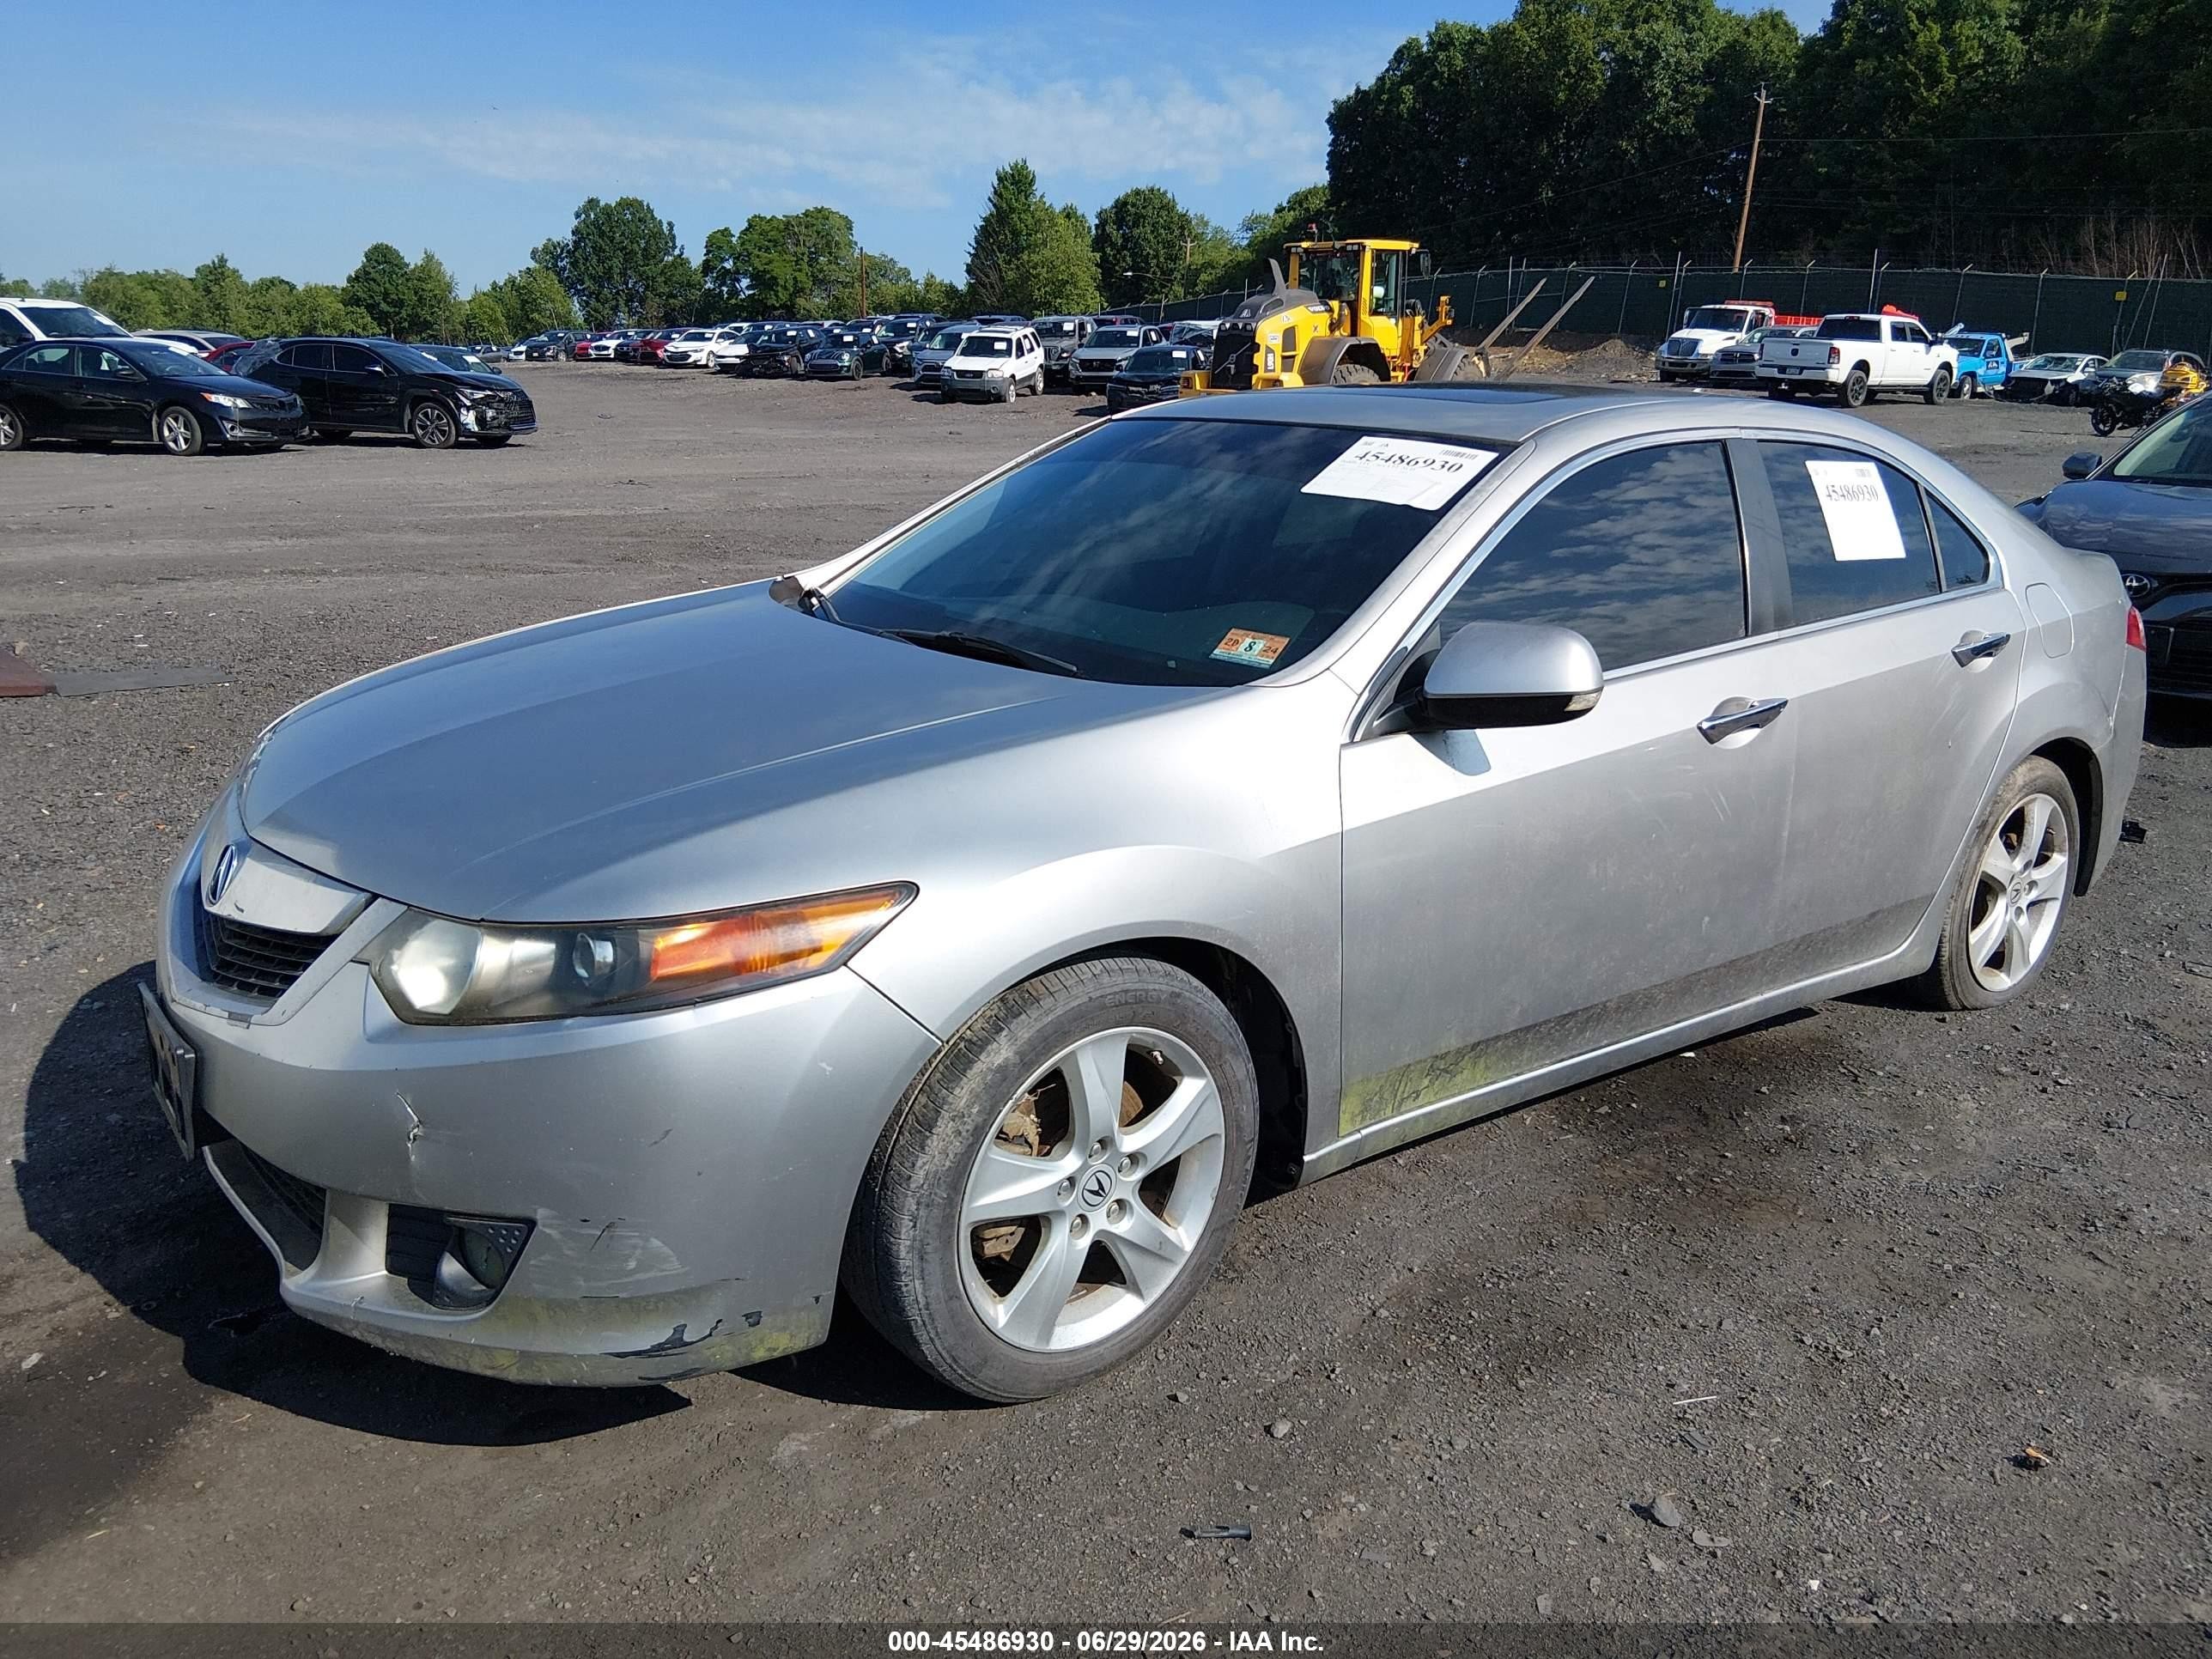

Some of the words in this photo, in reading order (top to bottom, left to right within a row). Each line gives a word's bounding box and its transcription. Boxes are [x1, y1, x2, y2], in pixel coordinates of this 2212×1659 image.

[1354, 450, 1463, 473] 45486930
[1826, 484, 1879, 502] 45486930
[1243, 641, 1256, 653] 8
[1105, 990, 1167, 1007] ENERGY
